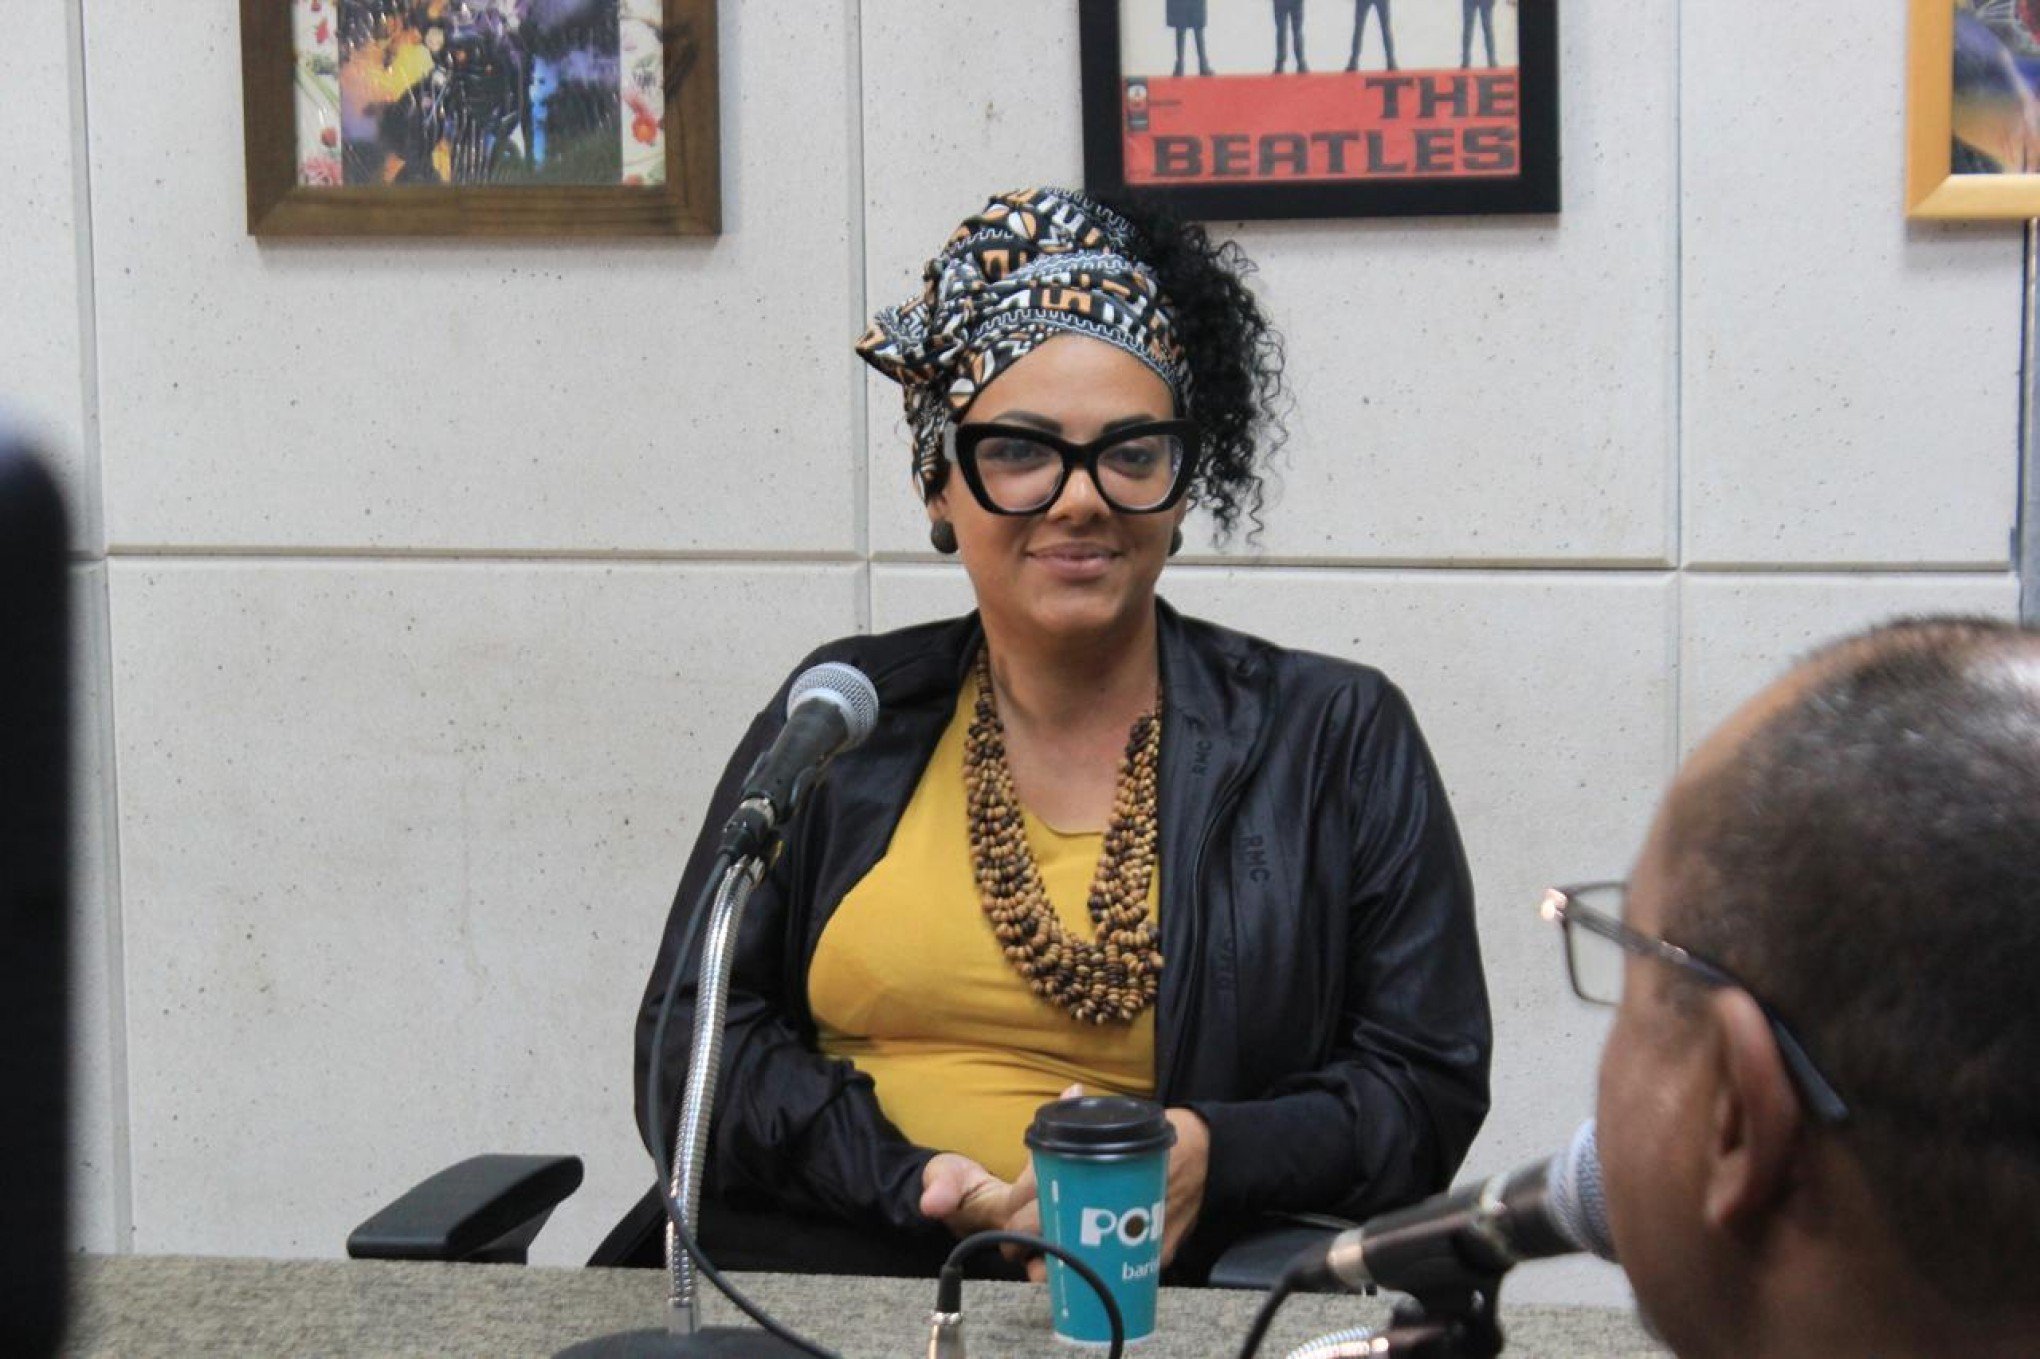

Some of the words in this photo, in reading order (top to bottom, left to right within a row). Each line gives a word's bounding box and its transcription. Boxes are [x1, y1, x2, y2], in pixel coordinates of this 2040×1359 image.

[1365, 75, 1516, 119] THE
[1152, 126, 1516, 178] BEATLES
[1245, 834, 1271, 883] RMC
